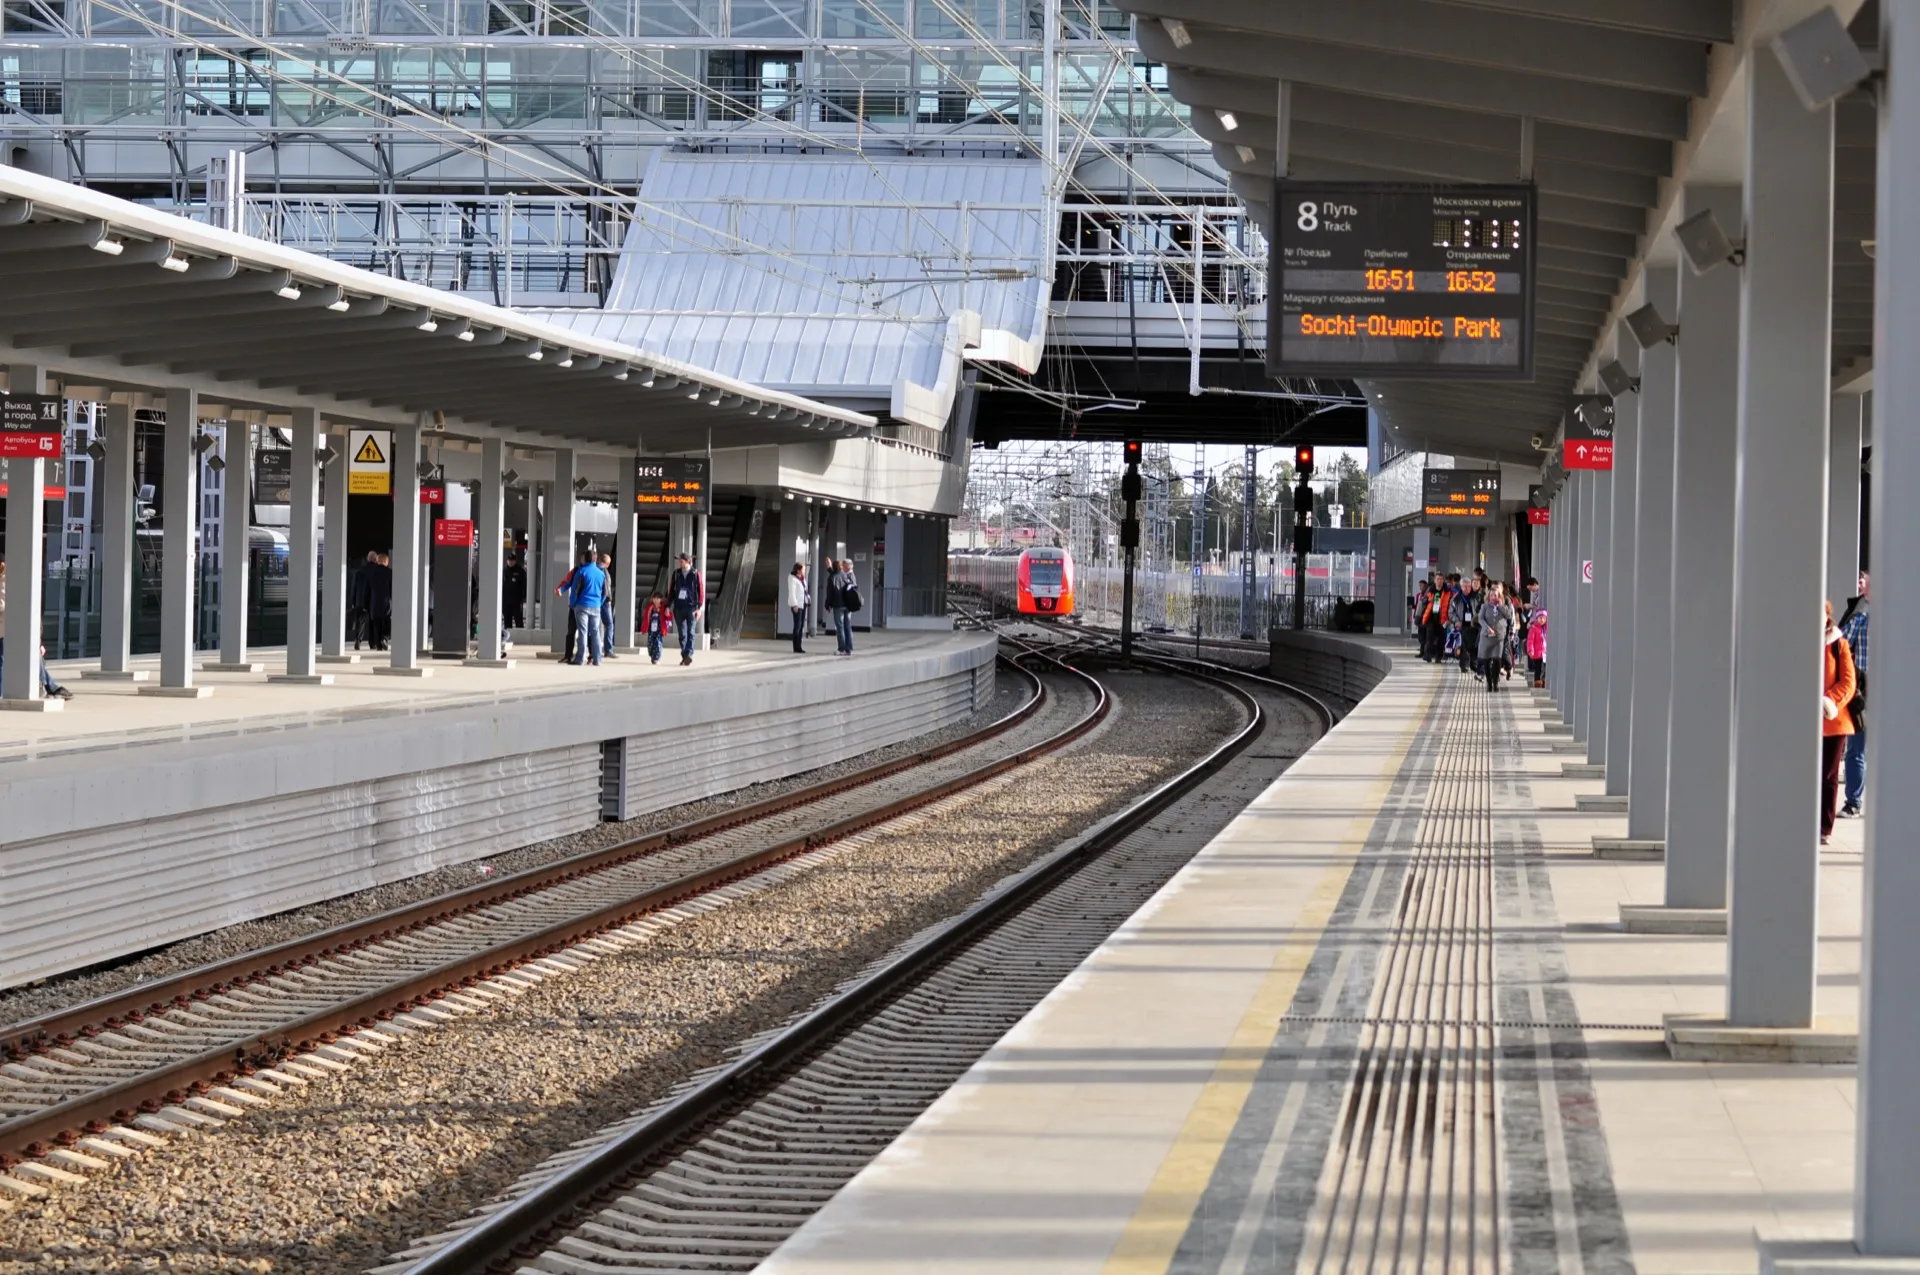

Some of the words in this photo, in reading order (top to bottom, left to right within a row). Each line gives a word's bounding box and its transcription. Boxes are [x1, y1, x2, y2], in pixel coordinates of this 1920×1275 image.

[1433, 196, 1490, 206] Московское
[1492, 198, 1521, 208] время
[1297, 201, 1318, 232] 8
[1323, 202, 1358, 218] Путь
[1323, 220, 1352, 232] Track
[1296, 248, 1331, 258] Поезда
[1364, 249, 1408, 259] Прибытие
[1446, 250, 1511, 261] Отправление
[1365, 269, 1415, 290] 16:51
[1446, 270, 1496, 292] 16:52
[1283, 293, 1327, 304] Маршрут
[1329, 295, 1385, 304] следования
[1301, 313, 1443, 338] Sochi-Olympic
[1455, 316, 1501, 338] Park
[4, 401, 32, 411] Выход
[11, 412, 37, 421] город
[4, 422, 19, 430] Way
[1592, 428, 1611, 438] Way
[4, 436, 36, 445] Автобусы
[263, 455, 270, 464] 6
[1430, 474, 1437, 484] 8
